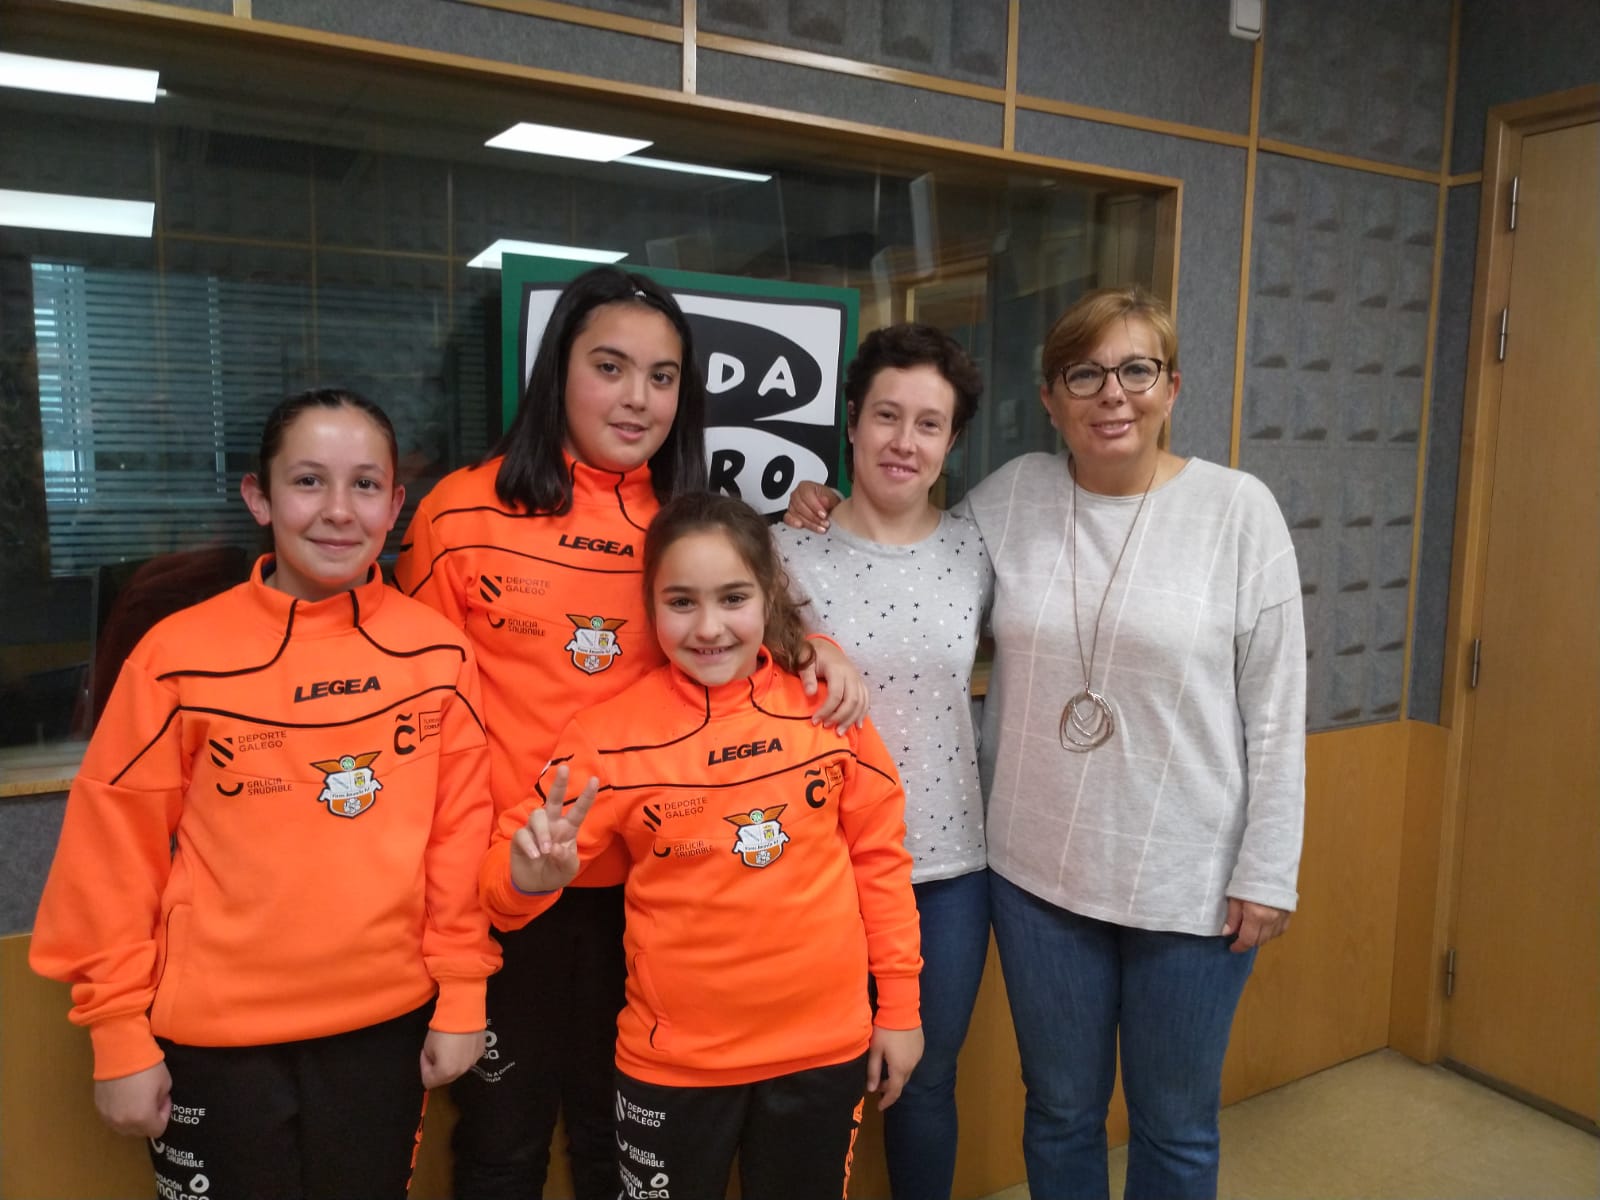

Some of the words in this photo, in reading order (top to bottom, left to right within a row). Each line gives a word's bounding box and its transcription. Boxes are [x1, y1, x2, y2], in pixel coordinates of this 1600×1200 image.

[705, 352, 797, 398] DA
[708, 448, 795, 500] RO
[558, 534, 634, 557] LEGEA
[505, 575, 550, 588] DEPORTE
[505, 584, 546, 596] GALEGO
[294, 676, 381, 702] LEGEA
[238, 730, 287, 744] DEPORTE
[238, 740, 284, 753] GALEGO
[707, 738, 783, 766] LEGEA
[246, 777, 283, 789] GALICIA
[247, 784, 293, 796] SAUDABLE
[664, 797, 708, 811] DEPORTE
[665, 806, 704, 819] GALEGO
[171, 1103, 206, 1116] PORTE
[628, 1102, 666, 1120] DEPORTE
[171, 1113, 199, 1124] LEGO
[627, 1111, 661, 1128] GALEGO
[166, 1145, 194, 1160] GALICIA
[629, 1145, 656, 1159] GALICIA
[166, 1152, 205, 1168] SAUDABLE
[629, 1151, 665, 1168] SAUDABLE
